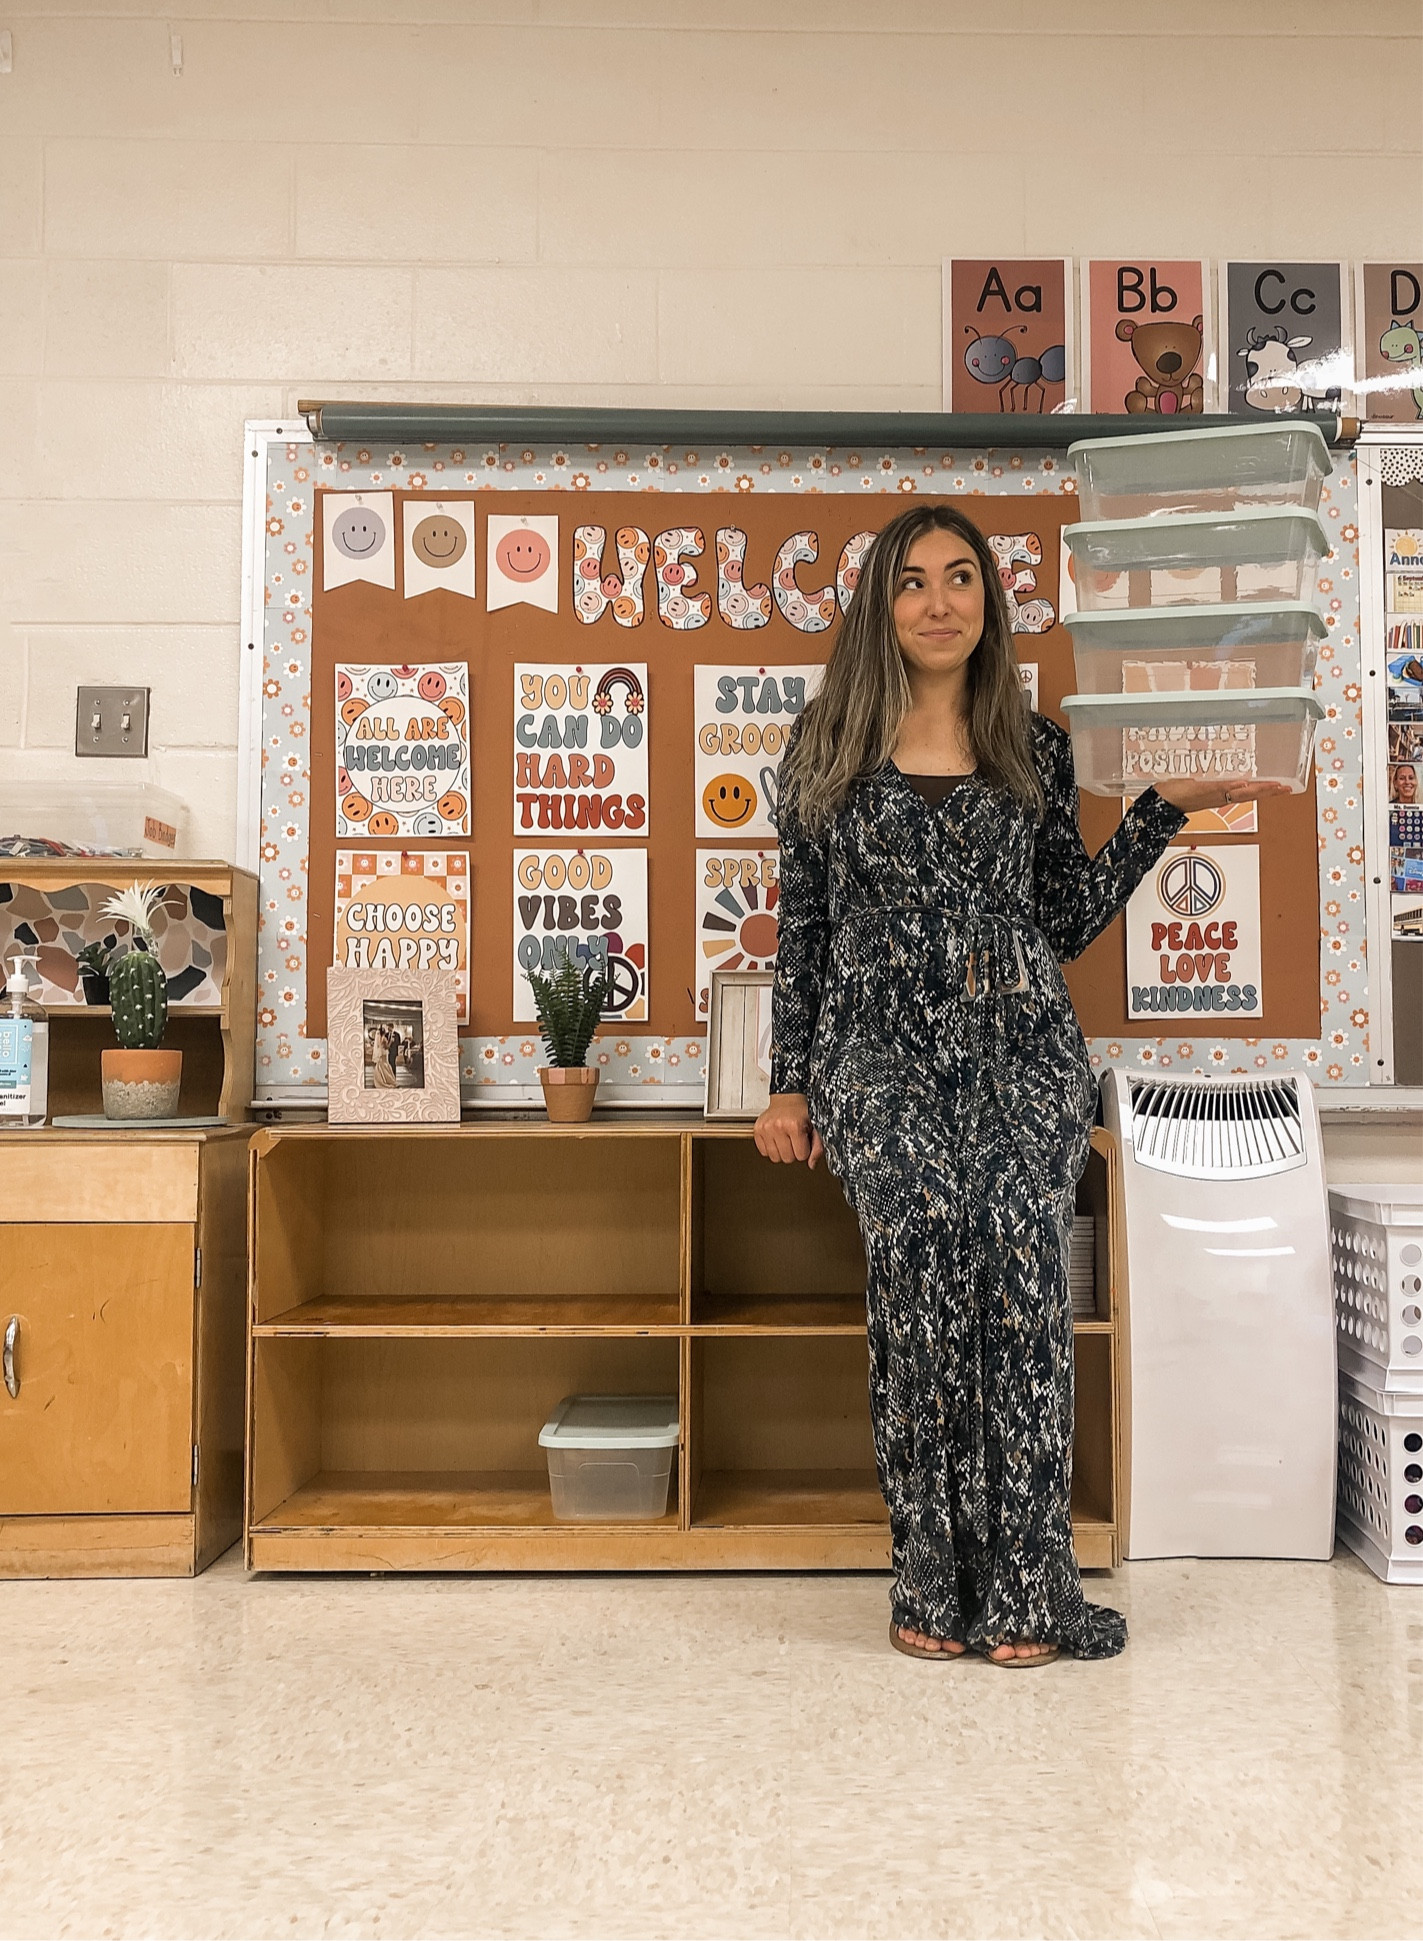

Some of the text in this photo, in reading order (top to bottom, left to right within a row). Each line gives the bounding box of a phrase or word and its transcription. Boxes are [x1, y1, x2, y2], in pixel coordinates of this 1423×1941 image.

[976, 267, 1042, 313] Aa
[1117, 266, 1178, 313] Bb
[1254, 269, 1317, 315] Cc
[1390, 553, 1423, 565] Ann
[573, 525, 1056, 633] WELCOE
[520, 674, 590, 710] YOU
[715, 676, 806, 714] STAY
[356, 716, 450, 741] ALL ARE
[516, 714, 643, 749] CAN DO
[699, 722, 792, 756] GROO
[345, 743, 460, 772] WELCOME
[515, 753, 615, 789] HARD
[1126, 749, 1254, 775] POSITIVITY
[370, 775, 437, 803] HERE
[515, 793, 646, 829] THINGS
[517, 854, 613, 891] GOOD
[346, 903, 456, 933] CHOOSE
[517, 894, 623, 931] VIBES
[518, 934, 609, 971] ONLY
[1151, 921, 1238, 950] PEACE
[345, 937, 460, 970] HAPPY
[1159, 953, 1231, 984] LOVE
[1131, 984, 1258, 1012] KINDNESS
